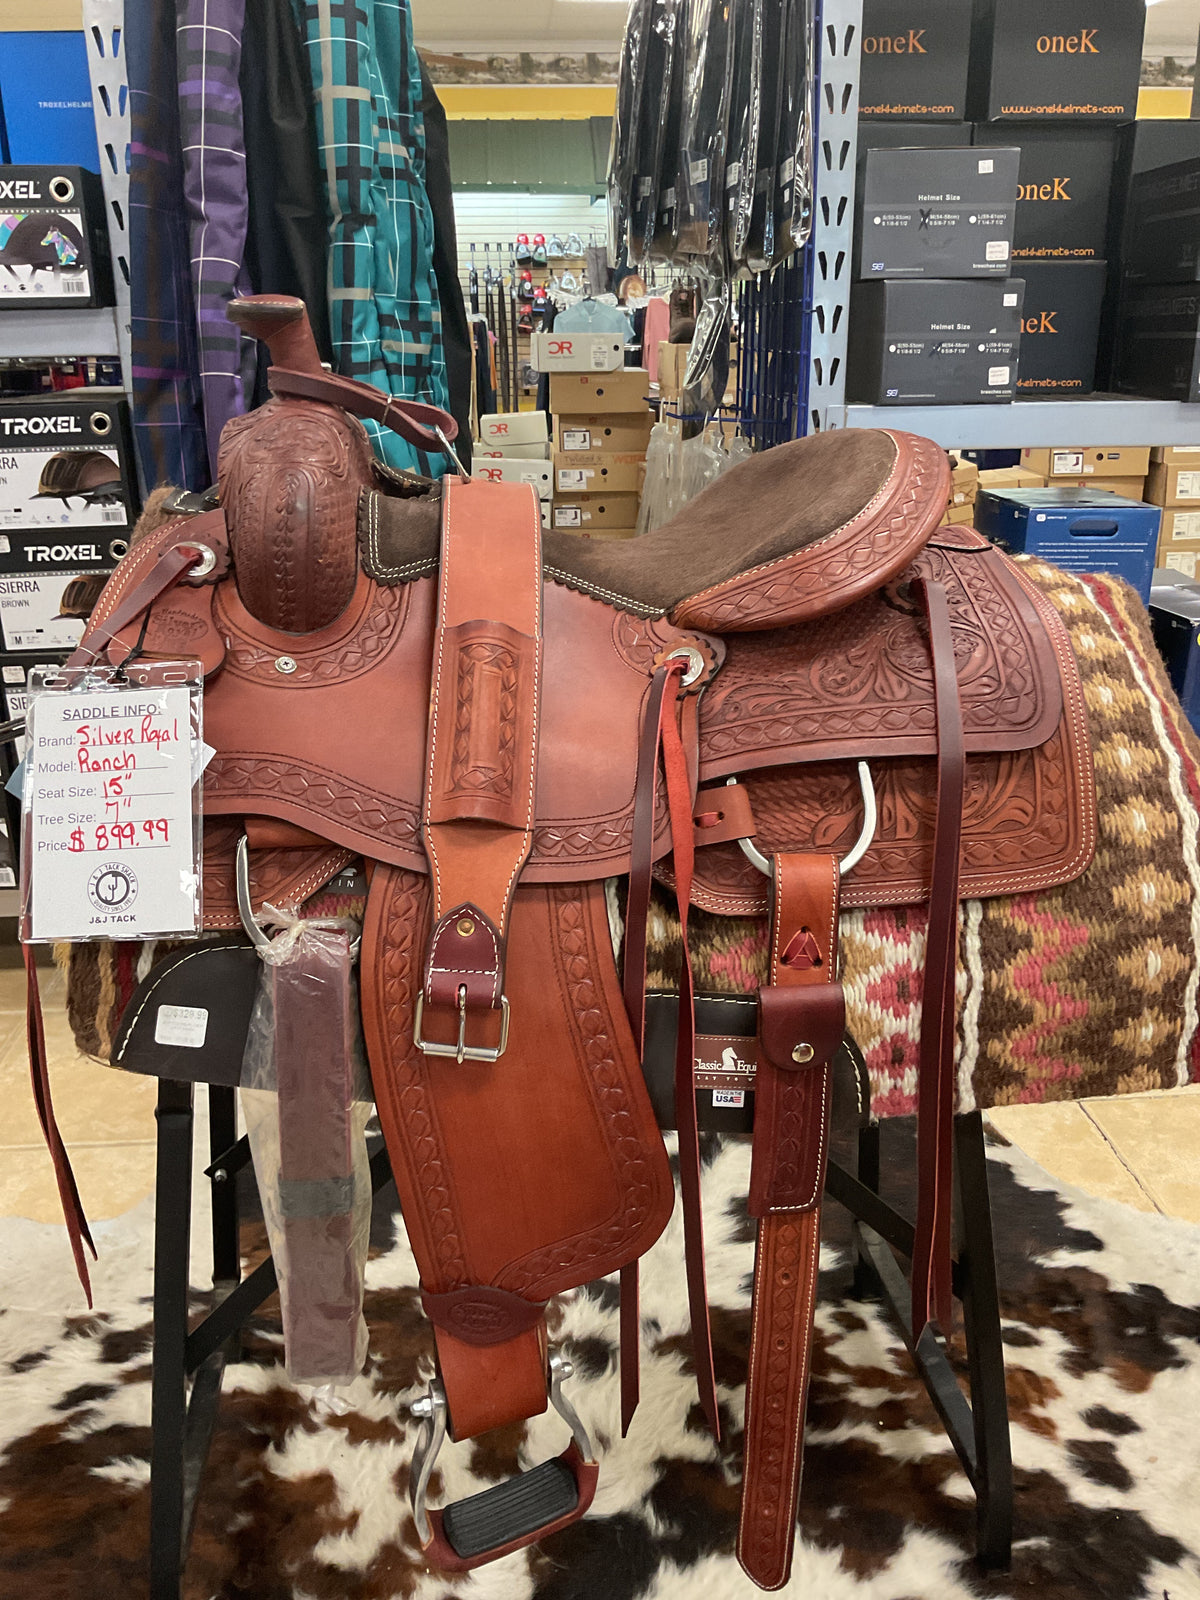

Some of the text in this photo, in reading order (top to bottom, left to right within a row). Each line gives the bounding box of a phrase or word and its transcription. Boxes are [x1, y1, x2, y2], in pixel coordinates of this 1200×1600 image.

[864, 29, 927, 53] oneK
[1037, 29, 1100, 53] oneK
[1016, 178, 1071, 200] oneK
[1, 416, 81, 435] TROXEL
[24, 544, 102, 562] TROXEL
[0, 581, 40, 594] SIERRA
[2, 600, 30, 608] BROWN
[63, 704, 162, 721] SADDLE INFO:
[39, 736, 76, 747] Brand:
[38, 747, 136, 773] Model: Ranch
[38, 789, 64, 799] Seat
[68, 786, 97, 797] Size:
[38, 815, 64, 825] Tree
[67, 812, 97, 824] Size:
[38, 841, 70, 852] Price:
[96, 818, 168, 850] 899.99
[89, 915, 136, 924] J&J TACK
[694, 1058, 757, 1074] Classic Equi
